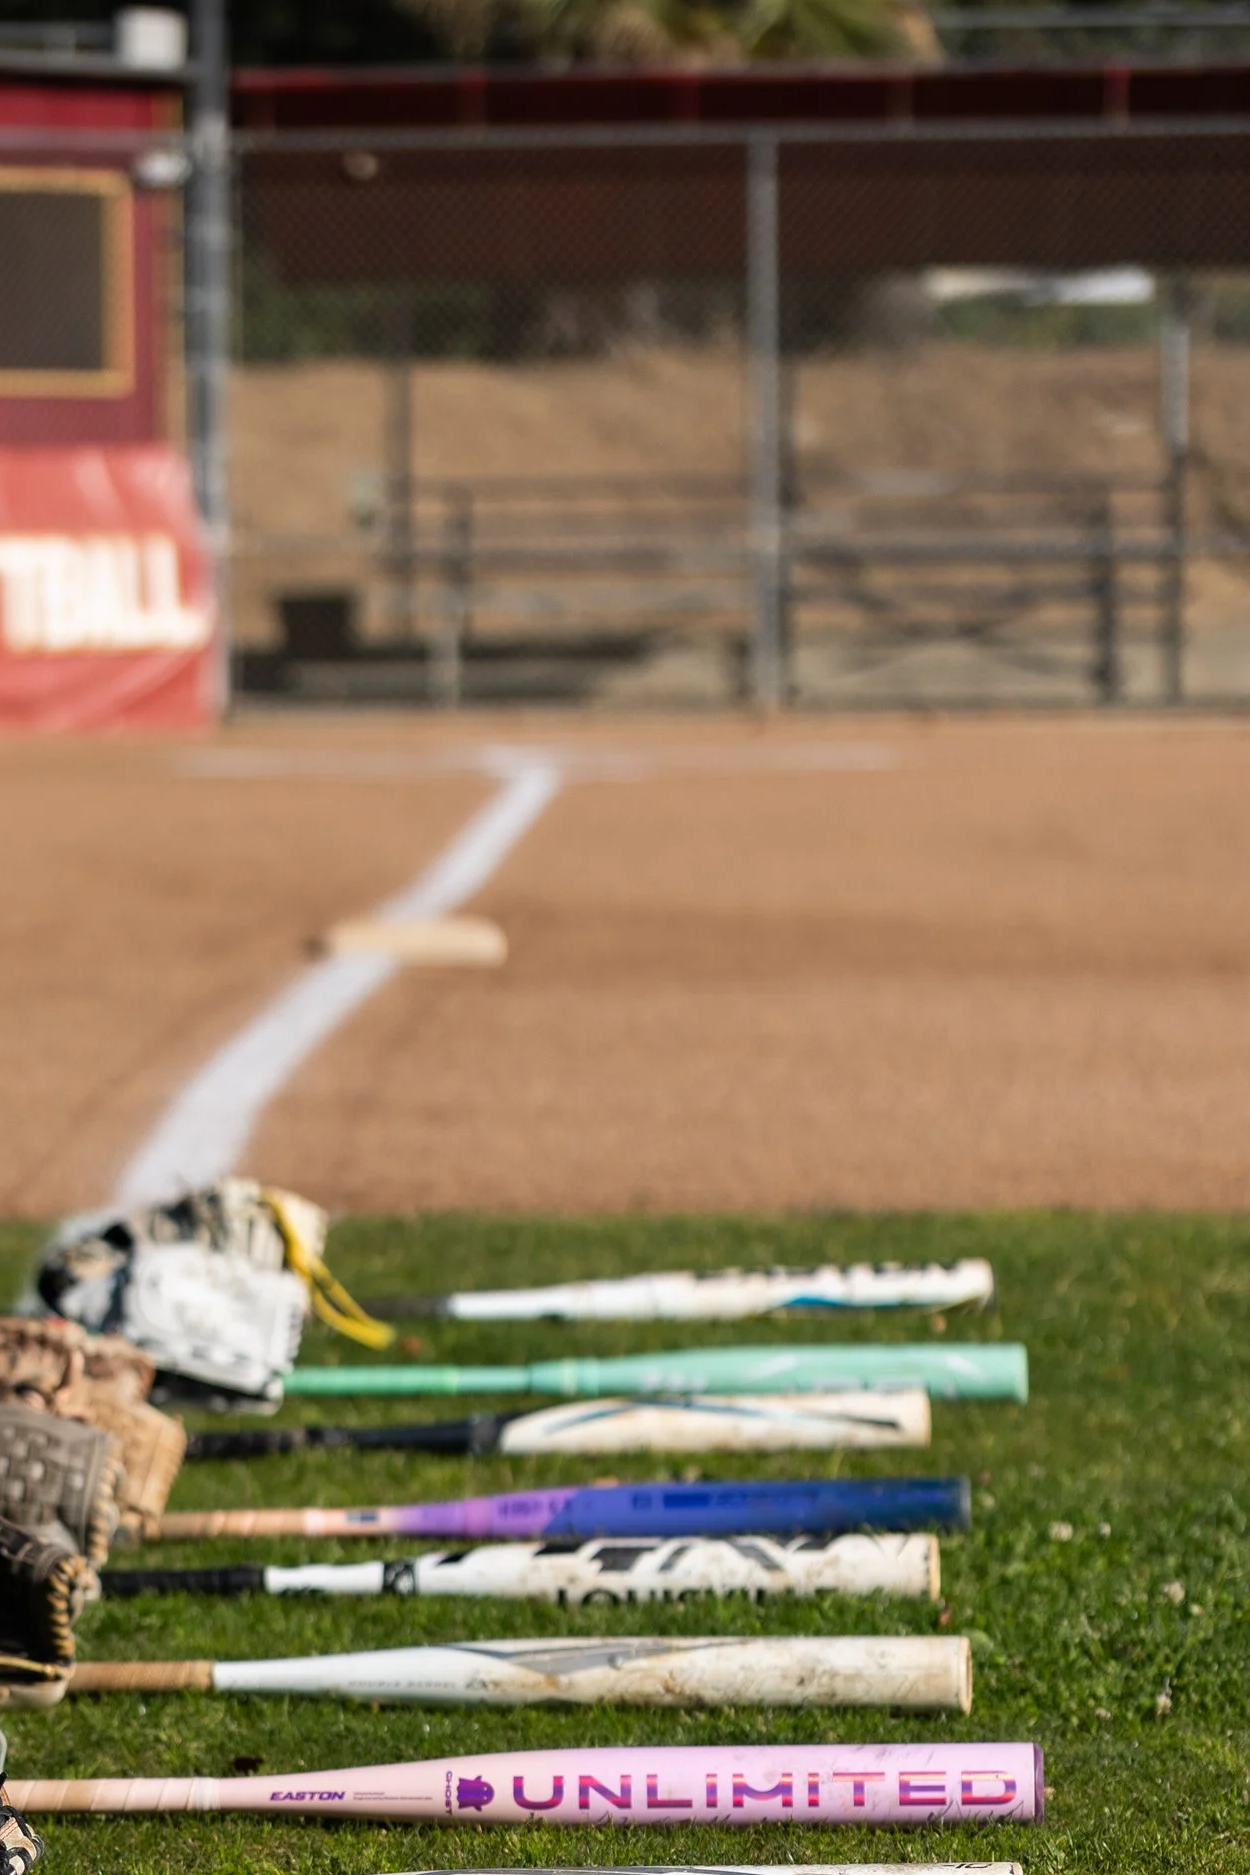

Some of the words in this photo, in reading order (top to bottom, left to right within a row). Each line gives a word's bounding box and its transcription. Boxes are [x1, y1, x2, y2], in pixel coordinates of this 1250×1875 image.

[269, 1791, 346, 1802] EASTON
[445, 1770, 453, 1815] GHOST
[512, 1771, 1018, 1810] UNLIMITED
